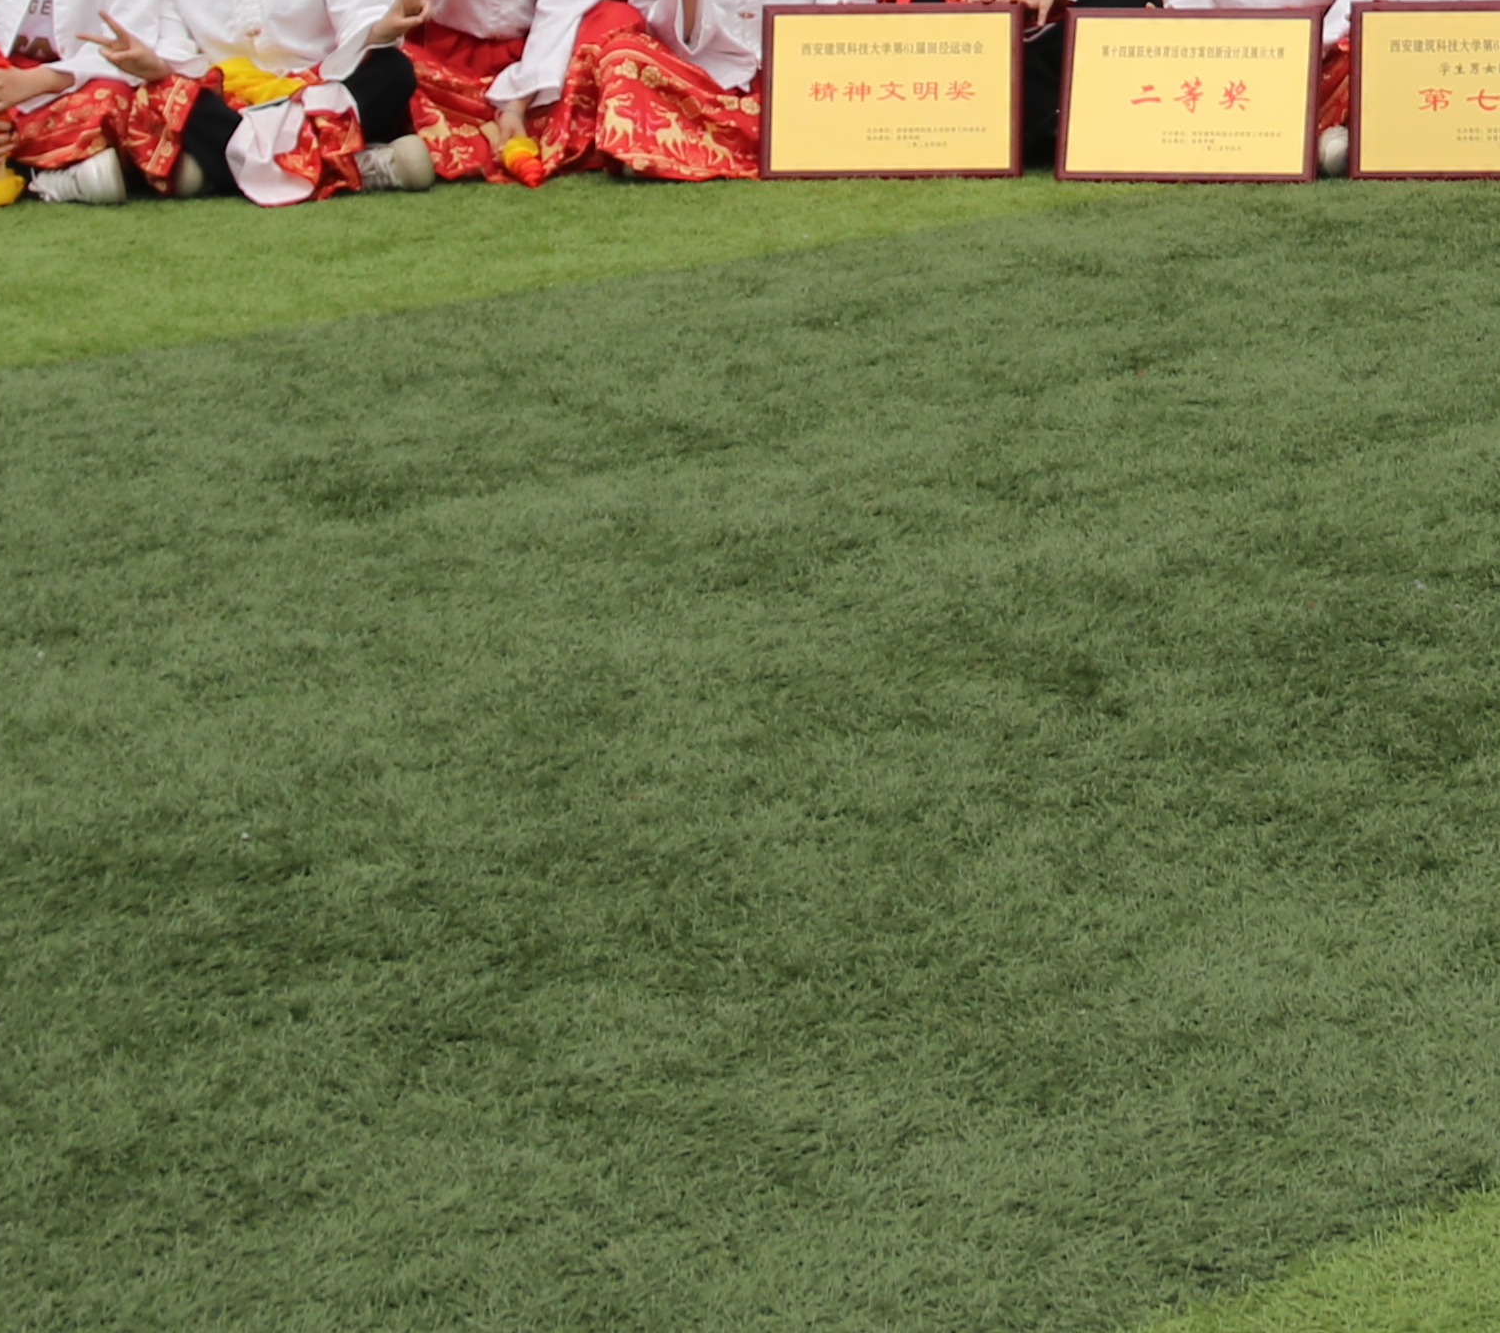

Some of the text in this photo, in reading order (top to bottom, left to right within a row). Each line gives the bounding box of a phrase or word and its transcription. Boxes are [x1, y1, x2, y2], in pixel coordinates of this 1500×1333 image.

[808, 80, 976, 102] 精神文明奖
[1130, 76, 1250, 113] 二等奖
